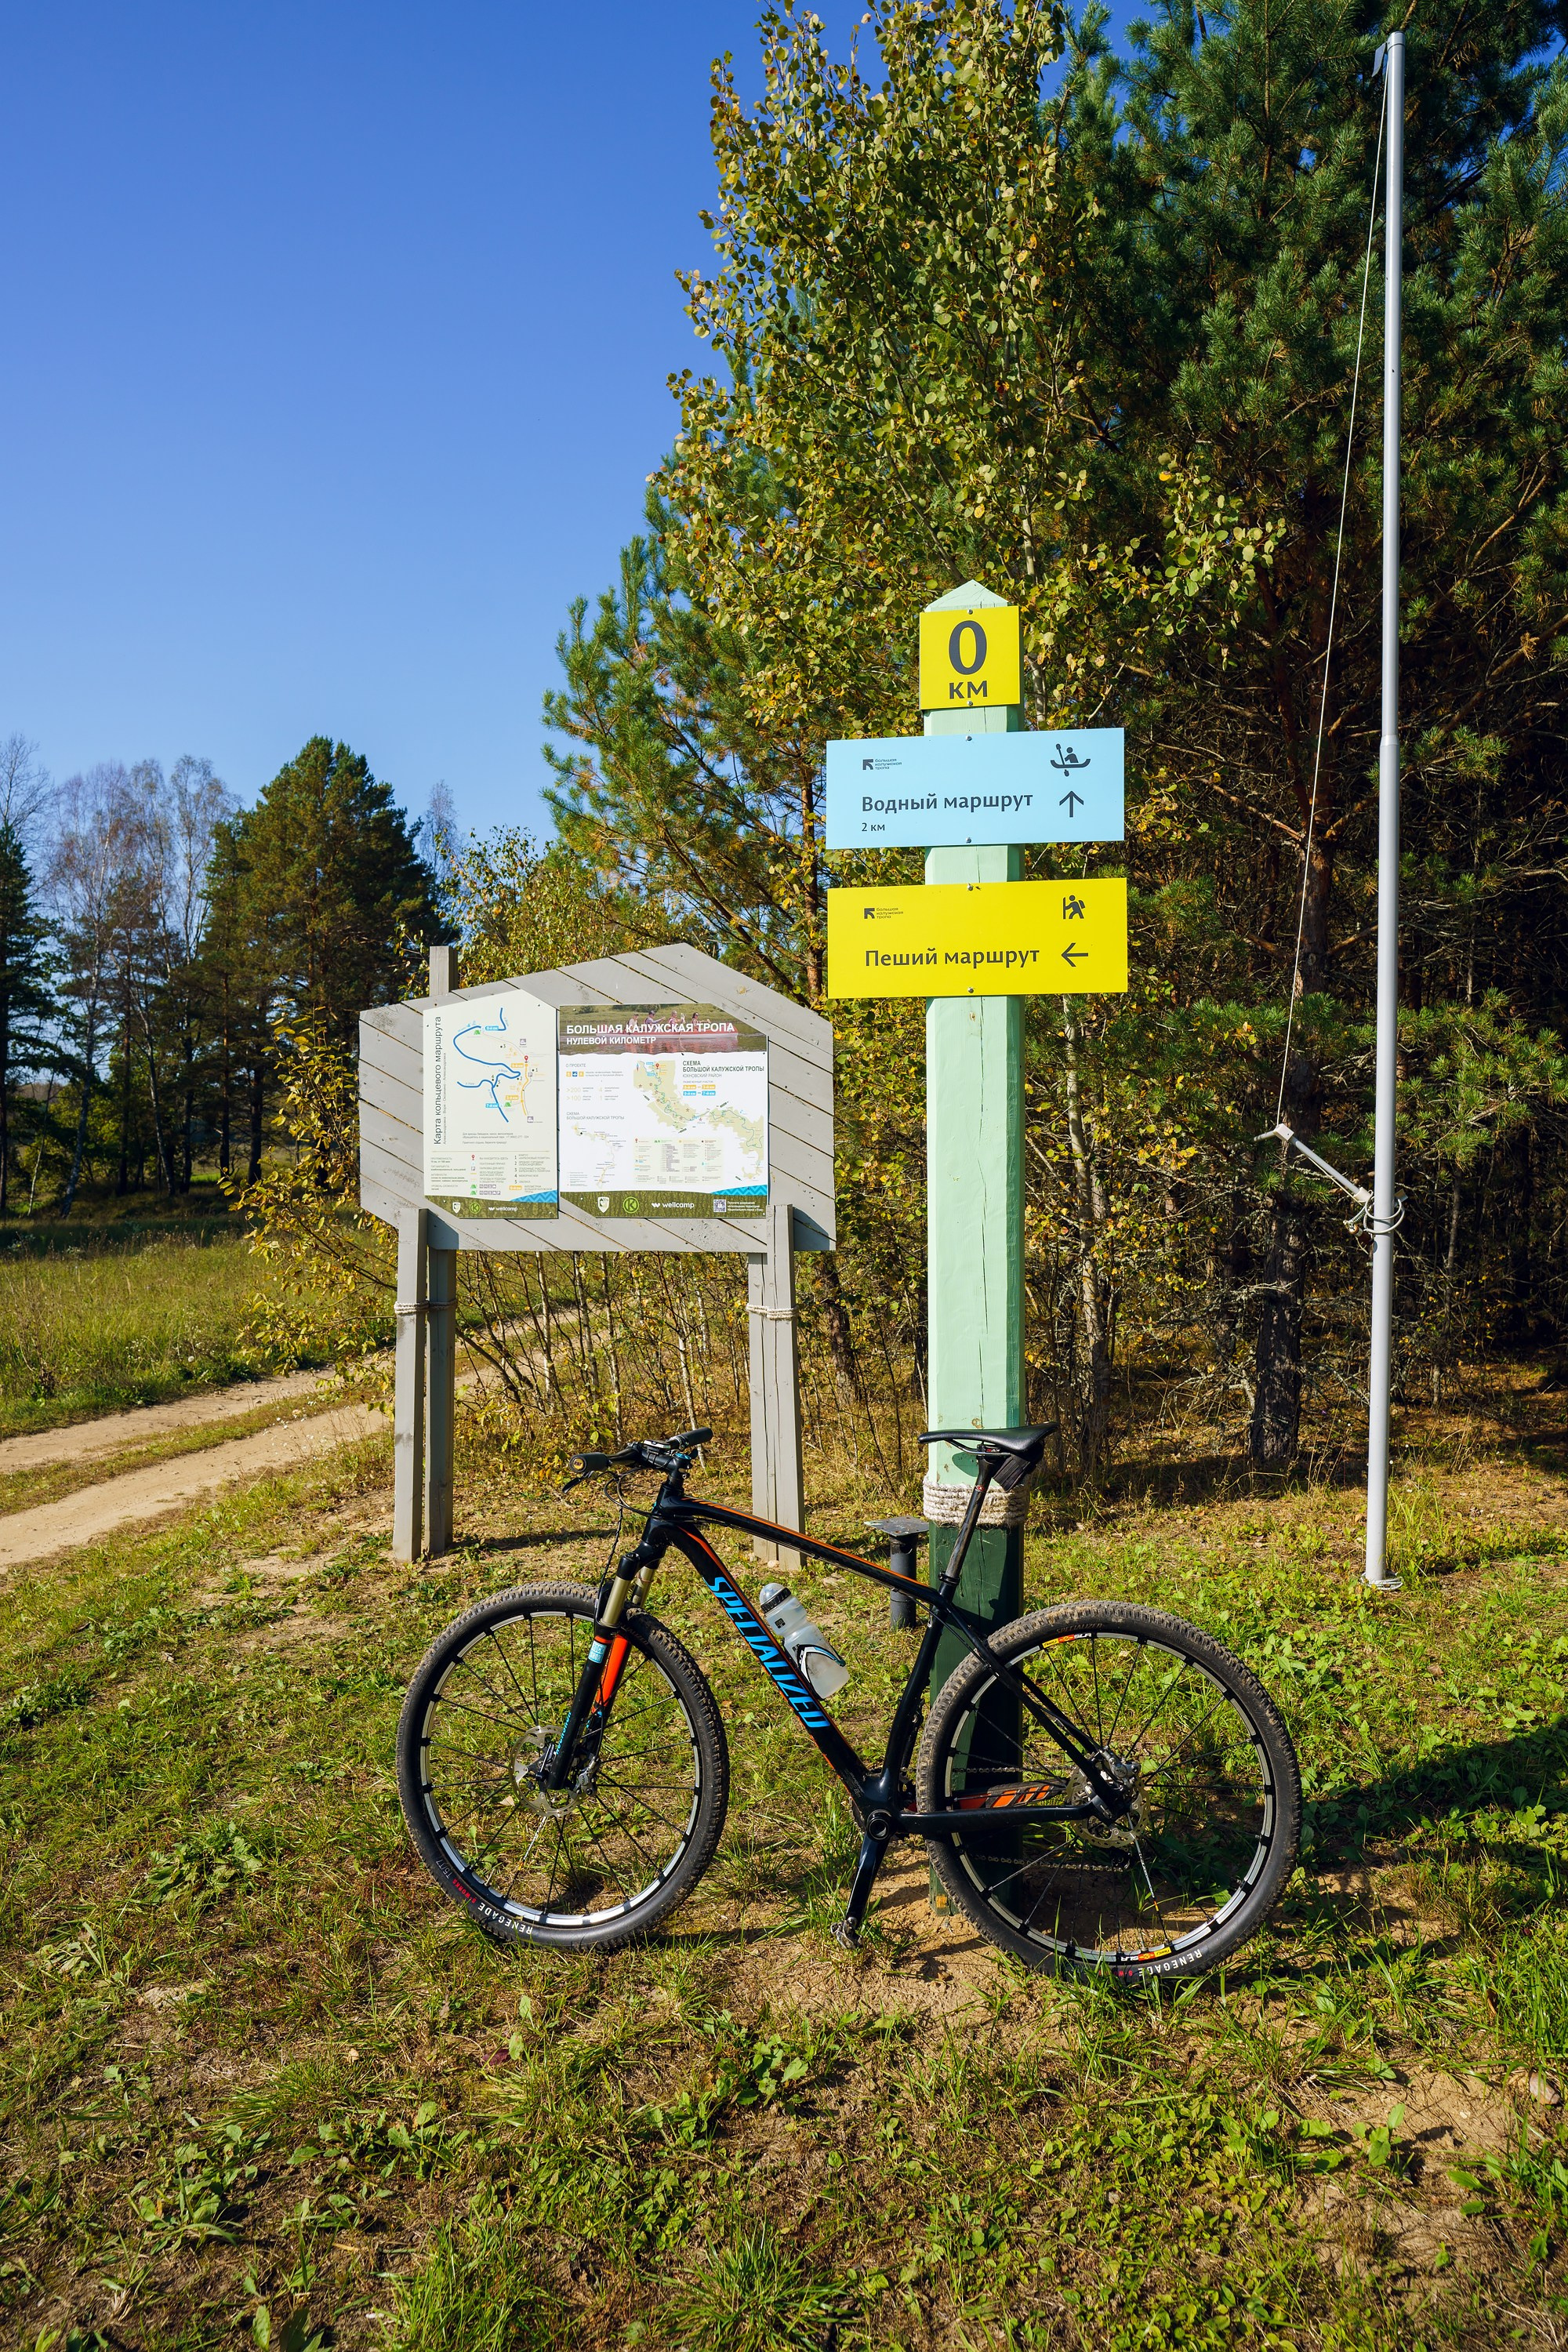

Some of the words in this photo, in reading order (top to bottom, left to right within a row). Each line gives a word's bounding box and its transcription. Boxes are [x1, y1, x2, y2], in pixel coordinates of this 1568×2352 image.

[949, 620, 987, 675] 0
[862, 793, 937, 814] Водный
[944, 794, 1033, 813] маршрут
[862, 822, 867, 832] 2
[866, 947, 938, 967] Пеший
[944, 949, 1040, 969] маршрут
[434, 1016, 443, 1062] маршрута
[566, 1024, 623, 1034] БОЛЬШАЯ
[626, 1023, 694, 1034] КАЛУЖСКАЯ
[696, 1022, 735, 1033] ТРОПА
[566, 1036, 608, 1045] НУЛЕВОЙ
[609, 1036, 656, 1044] КИЛОМЕТР
[434, 1118, 443, 1145] Карта
[703, 1577, 830, 1728] SPECIALIZED
[452, 1878, 477, 1904] S-WORKS
[477, 1902, 533, 1935] RENEGADE
[1138, 1948, 1203, 1977] RENEGADE
